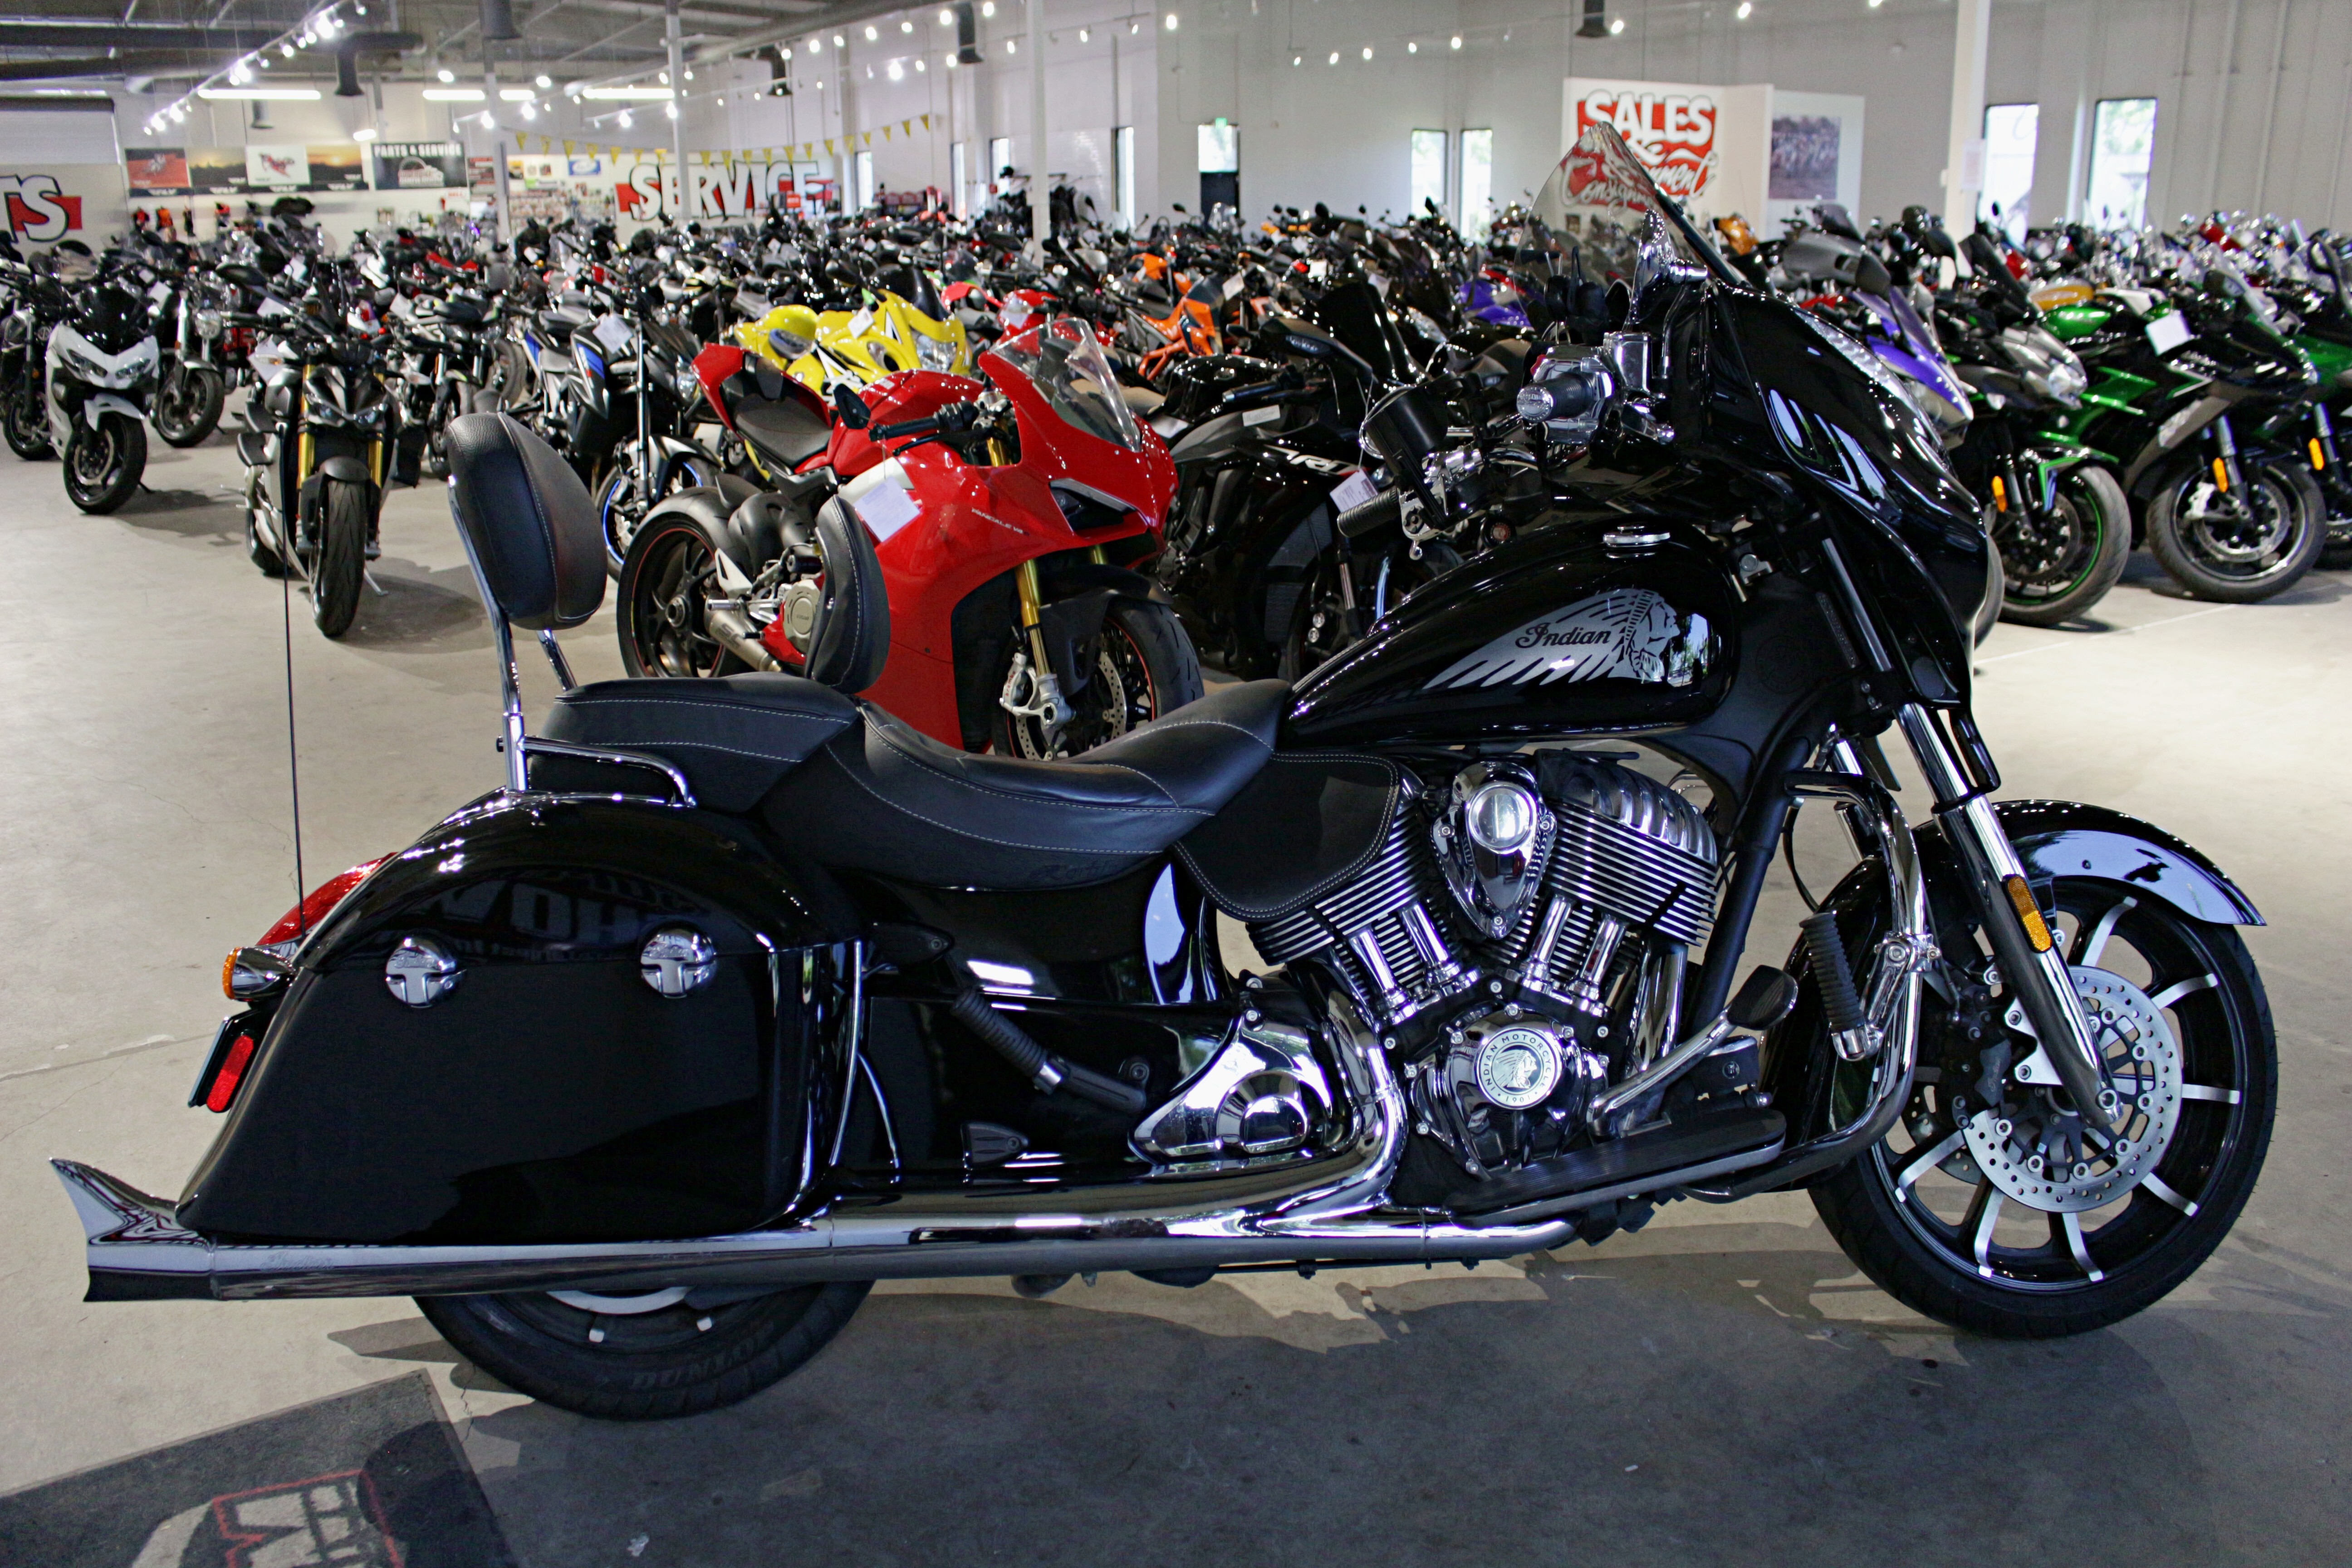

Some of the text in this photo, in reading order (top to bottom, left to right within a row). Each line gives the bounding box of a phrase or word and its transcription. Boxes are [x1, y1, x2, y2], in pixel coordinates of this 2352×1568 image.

[1585, 89, 1714, 146] SALES
[374, 144, 408, 157] PARTS
[418, 143, 462, 157] SERVICE
[630, 160, 818, 221] SERVICE
[1515, 622, 1611, 649] Indian
[1483, 1034, 1551, 1091] INDIAN MOTORCYCLE
[1505, 1094, 1531, 1103] 1901
